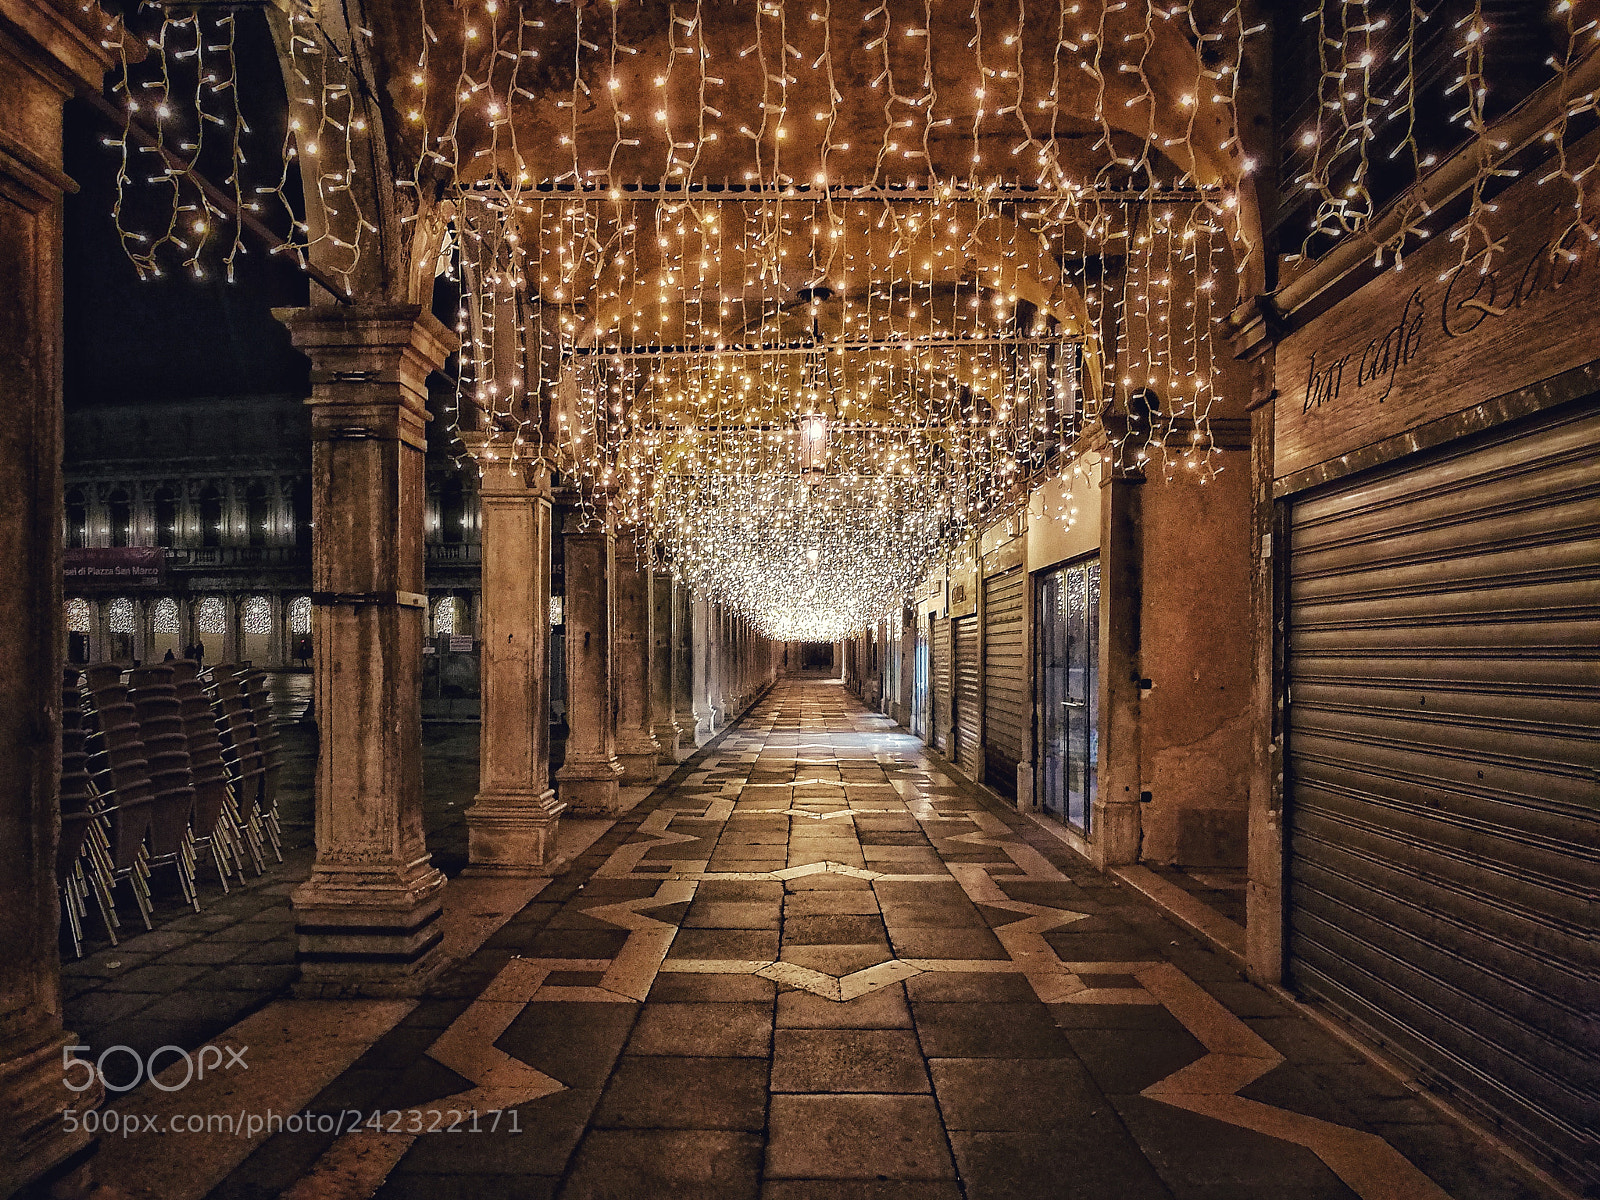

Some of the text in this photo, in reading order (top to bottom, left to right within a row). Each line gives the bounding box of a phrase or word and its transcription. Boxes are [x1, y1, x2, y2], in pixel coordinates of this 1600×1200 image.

[1302, 350, 1351, 415] bar
[78, 567, 86, 576] di
[87, 567, 114, 576] Piazza
[115, 566, 131, 576] San
[132, 566, 159, 576] Marco
